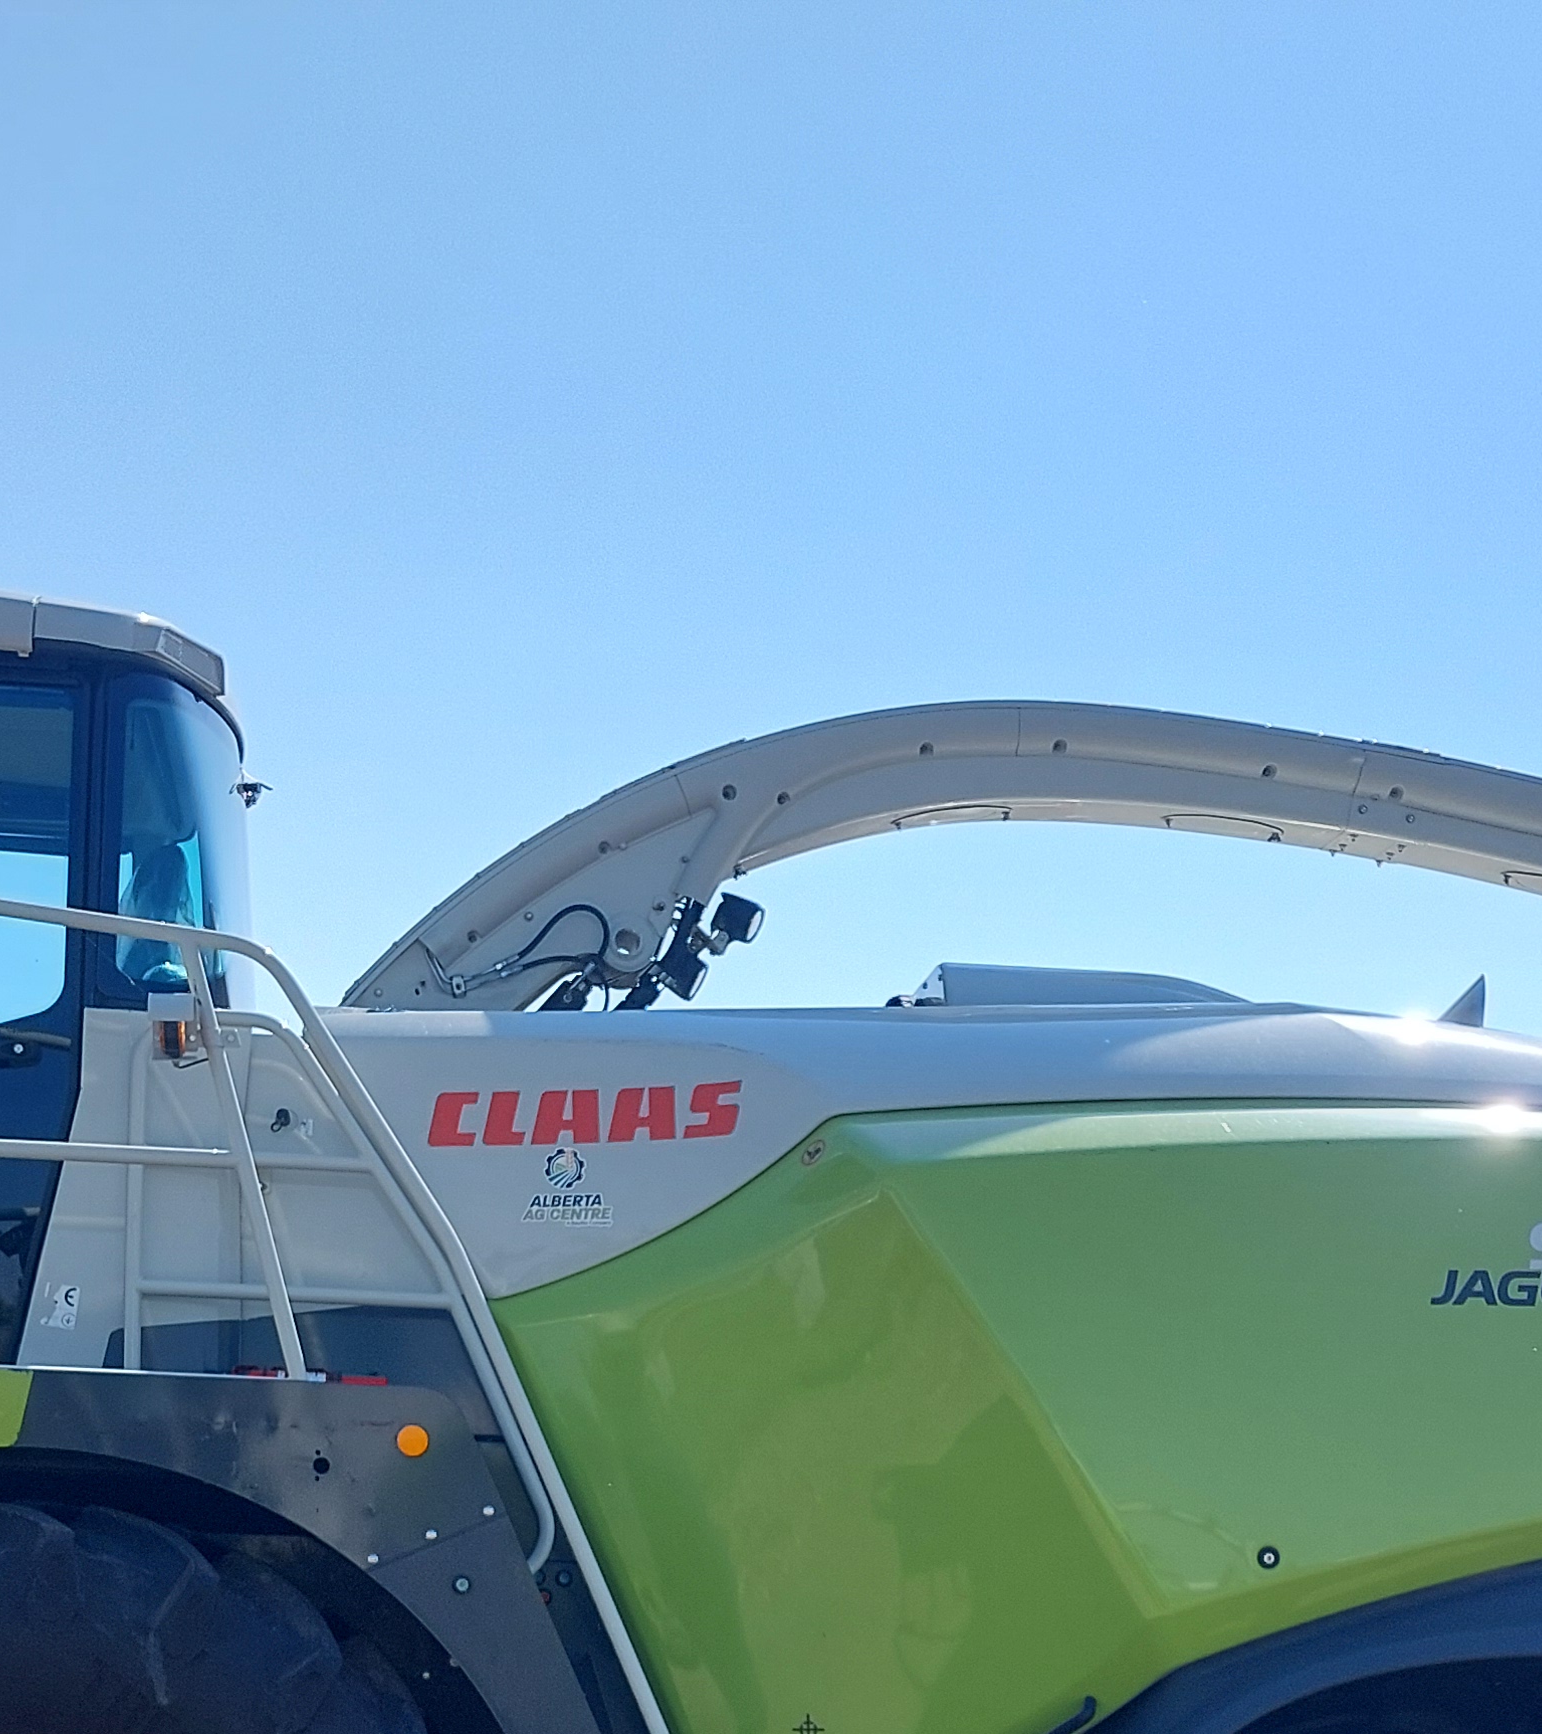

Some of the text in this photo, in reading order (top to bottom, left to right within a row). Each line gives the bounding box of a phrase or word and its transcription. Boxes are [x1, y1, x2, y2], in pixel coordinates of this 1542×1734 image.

[427, 1080, 742, 1147] CLAAS
[529, 1193, 603, 1208] ALBERTA
[522, 1207, 612, 1221] AG CENTRE
